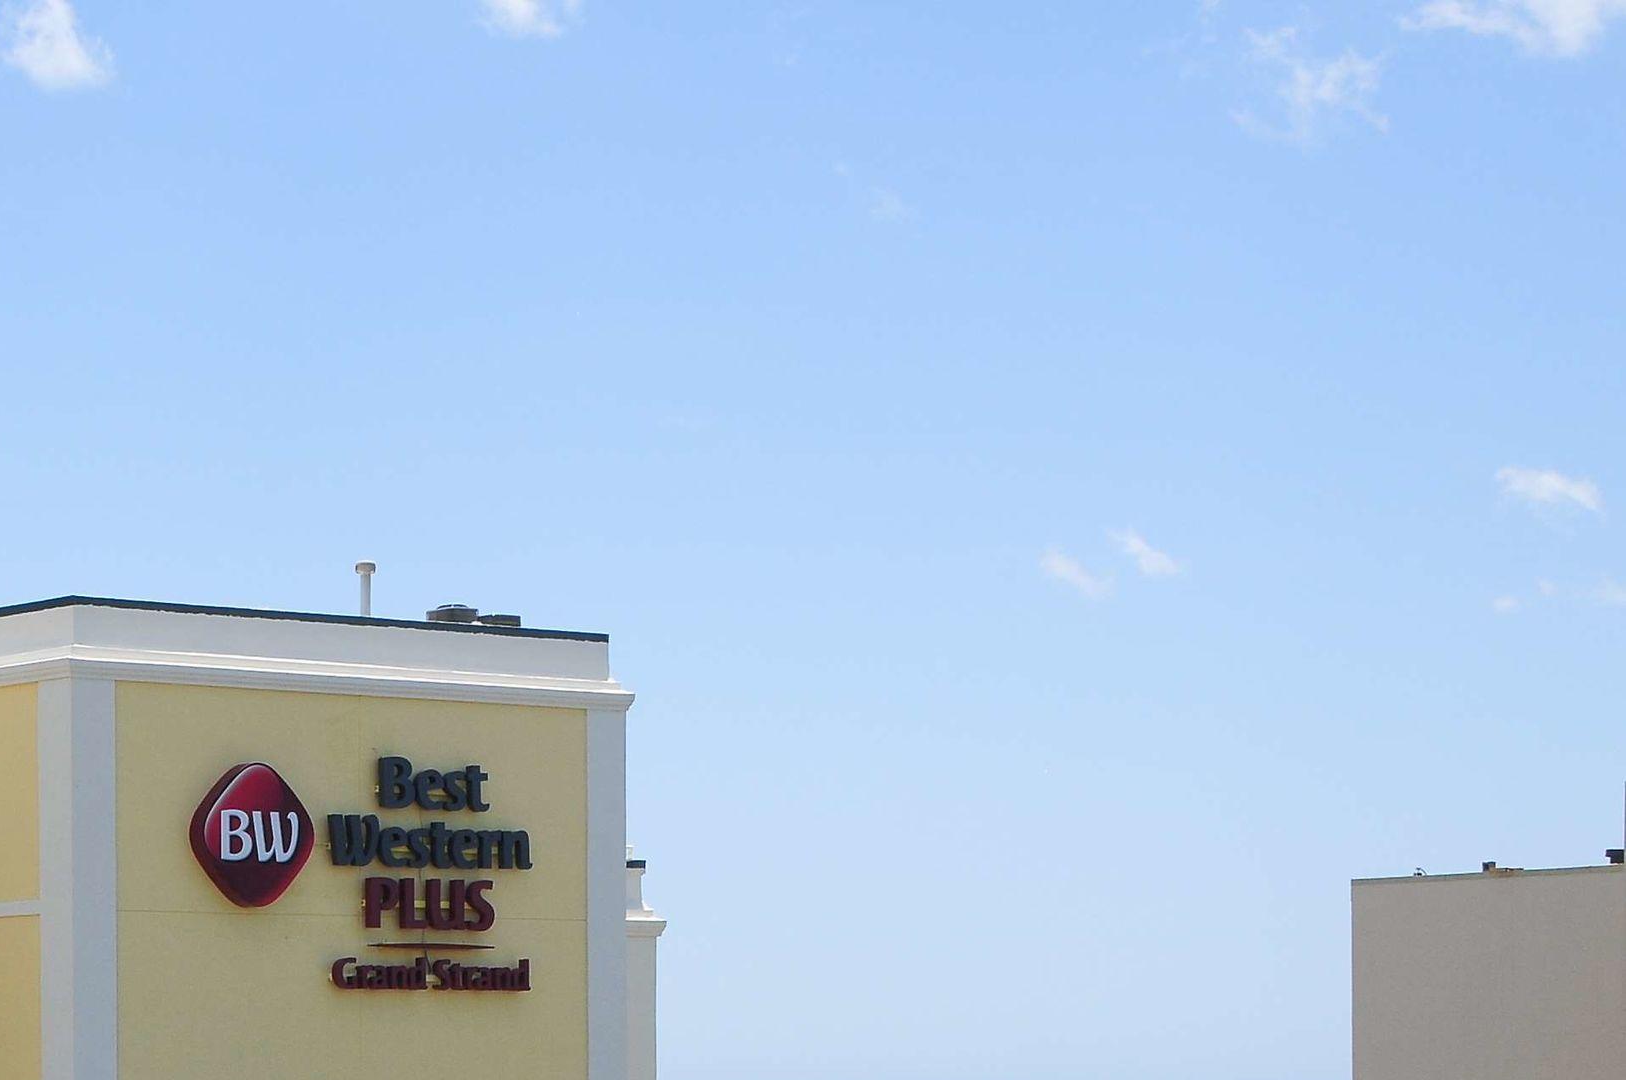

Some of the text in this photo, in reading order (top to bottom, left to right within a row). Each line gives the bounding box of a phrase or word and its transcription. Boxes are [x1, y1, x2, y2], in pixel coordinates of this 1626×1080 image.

[377, 756, 490, 813] Best
[219, 808, 299, 863] BW
[327, 813, 533, 870] Western
[363, 877, 496, 932] PLUS
[330, 957, 532, 992] Grand Strand
